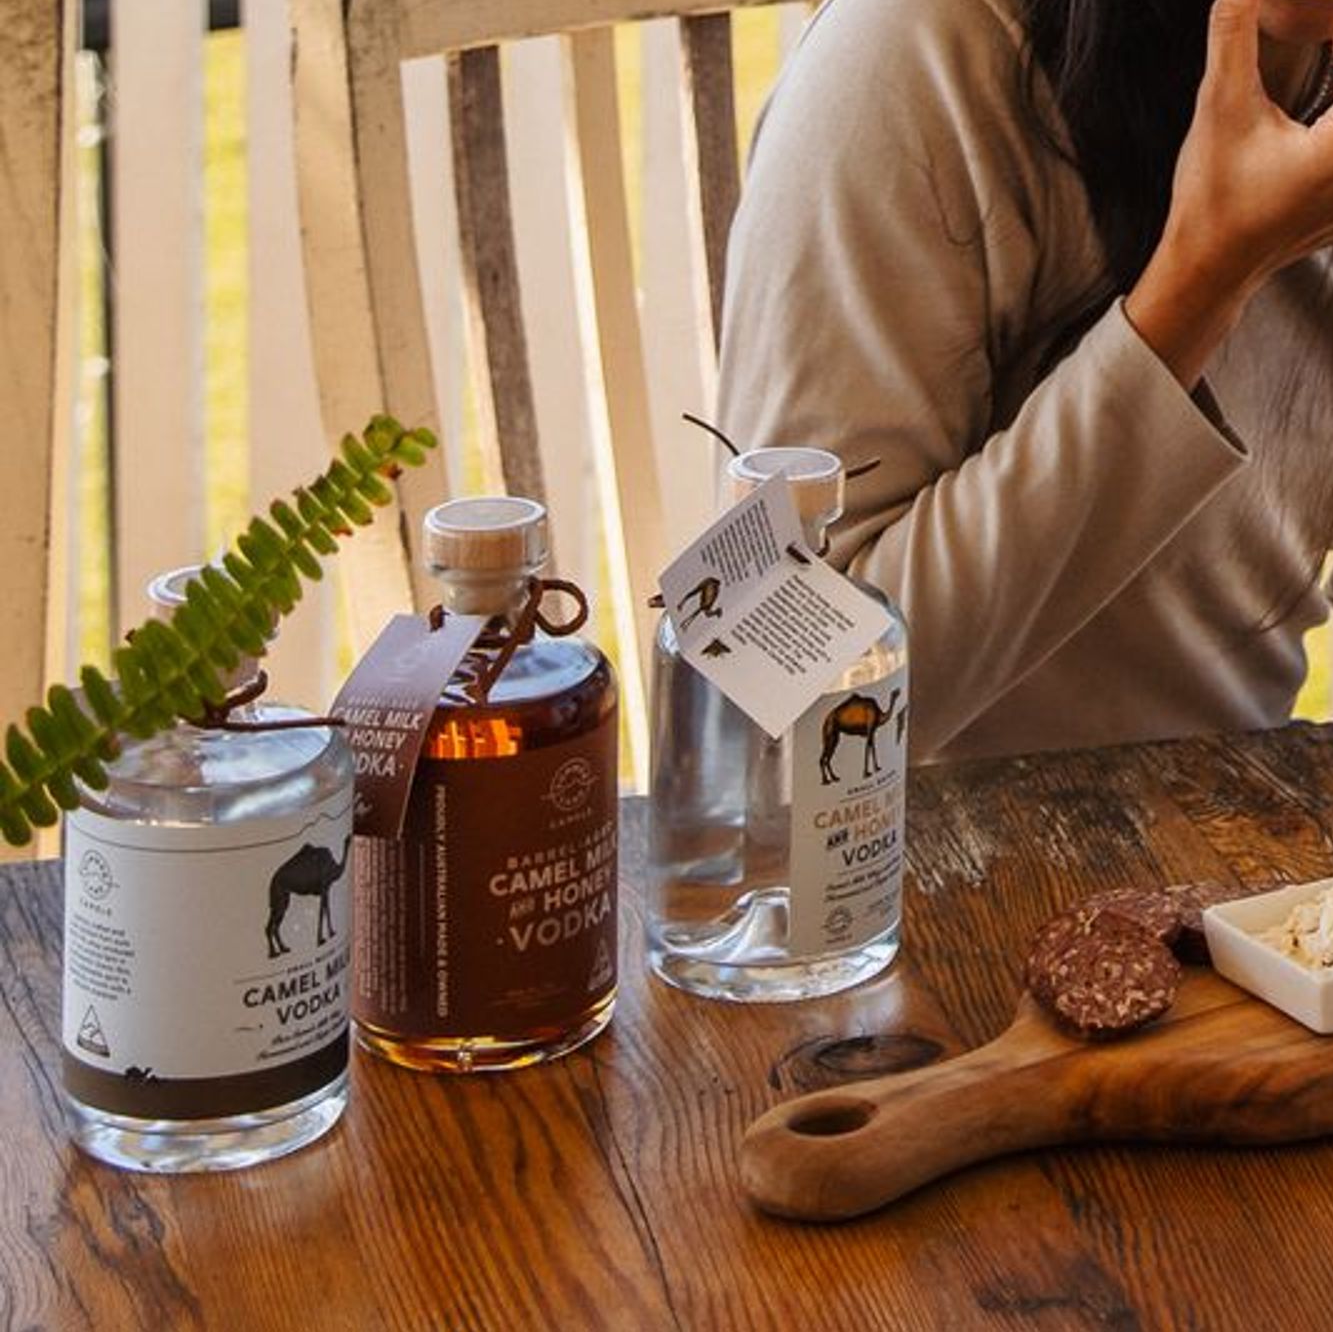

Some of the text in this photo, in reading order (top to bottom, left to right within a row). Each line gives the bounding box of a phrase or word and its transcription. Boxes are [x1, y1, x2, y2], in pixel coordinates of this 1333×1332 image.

[332, 708, 424, 731] CAMEL MILK
[351, 729, 408, 749] HONEY
[814, 798, 881, 829] CAMEL
[842, 829, 897, 866] VODKA
[436, 843, 447, 921] AUSTRALIAN
[489, 857, 581, 897] CAMEL
[543, 862, 612, 912] HONEY
[436, 922, 447, 956] MADE
[509, 890, 611, 952] VODKA
[243, 970, 321, 1008] CAMEL
[276, 982, 341, 1026] VODKA
[437, 970, 448, 1018] OWNED
